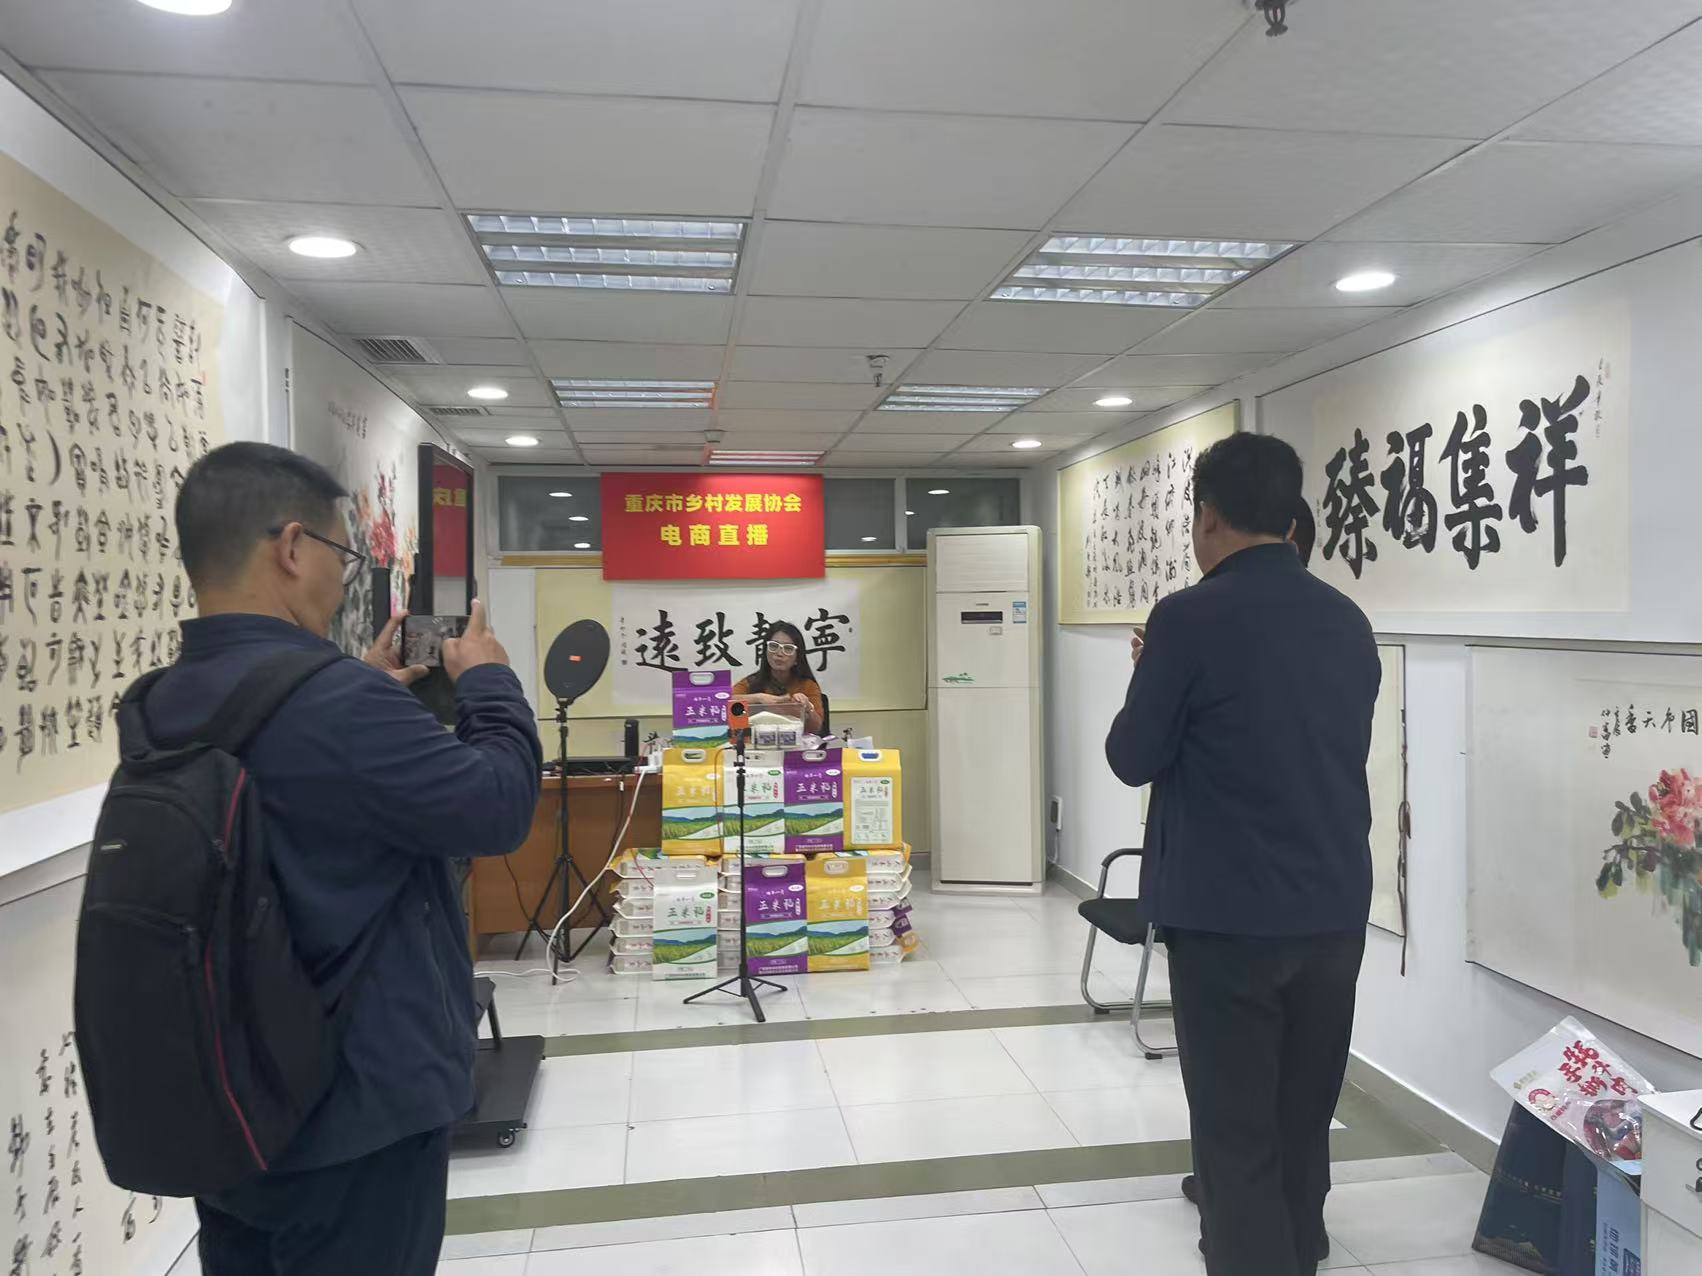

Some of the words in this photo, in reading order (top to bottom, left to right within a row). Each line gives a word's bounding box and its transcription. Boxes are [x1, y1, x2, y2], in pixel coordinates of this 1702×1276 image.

[625, 493, 802, 513] 重庆市乡村发展协会
[660, 524, 769, 546] 电商直播
